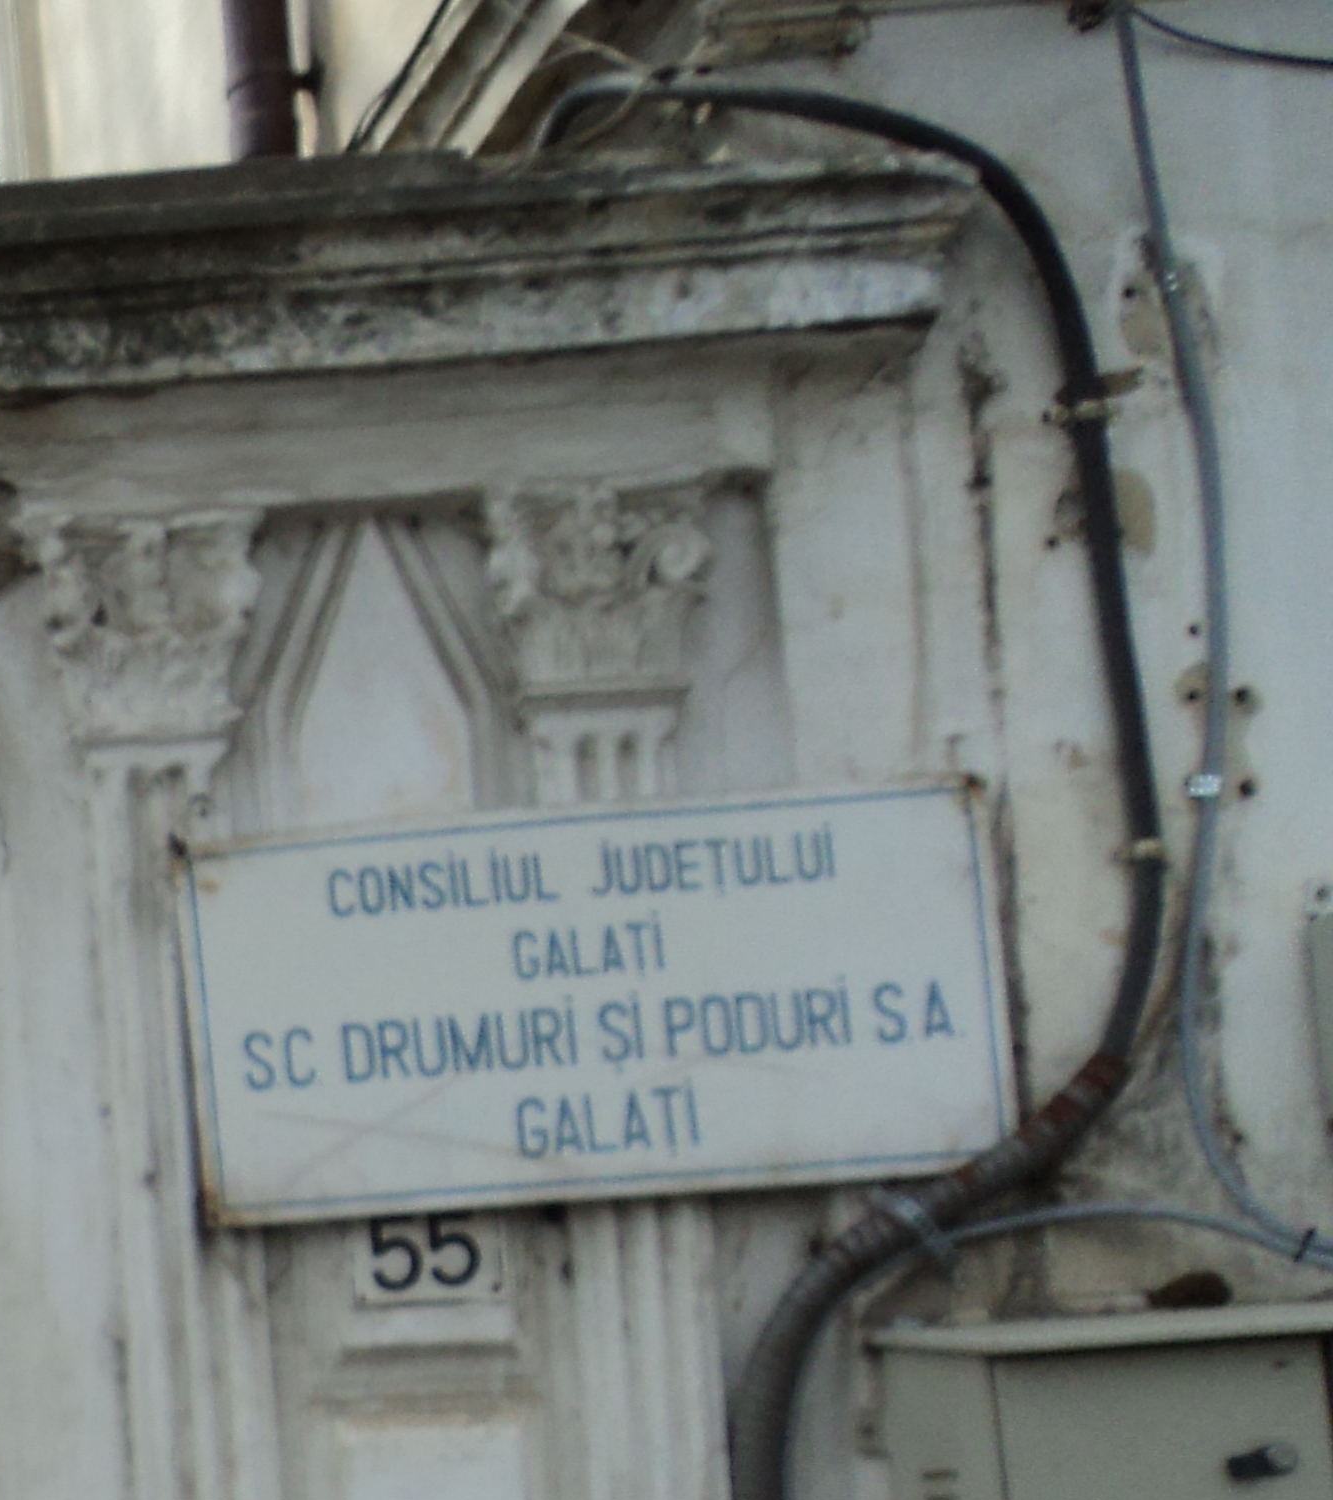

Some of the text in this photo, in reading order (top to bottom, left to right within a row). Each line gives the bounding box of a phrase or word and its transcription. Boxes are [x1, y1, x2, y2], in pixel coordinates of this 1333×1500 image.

[327, 847, 561, 919] CONSILIUL
[341, 995, 580, 1084] DRUMURI
[663, 973, 853, 1058] PODURI
[369, 1212, 483, 1292] 55
